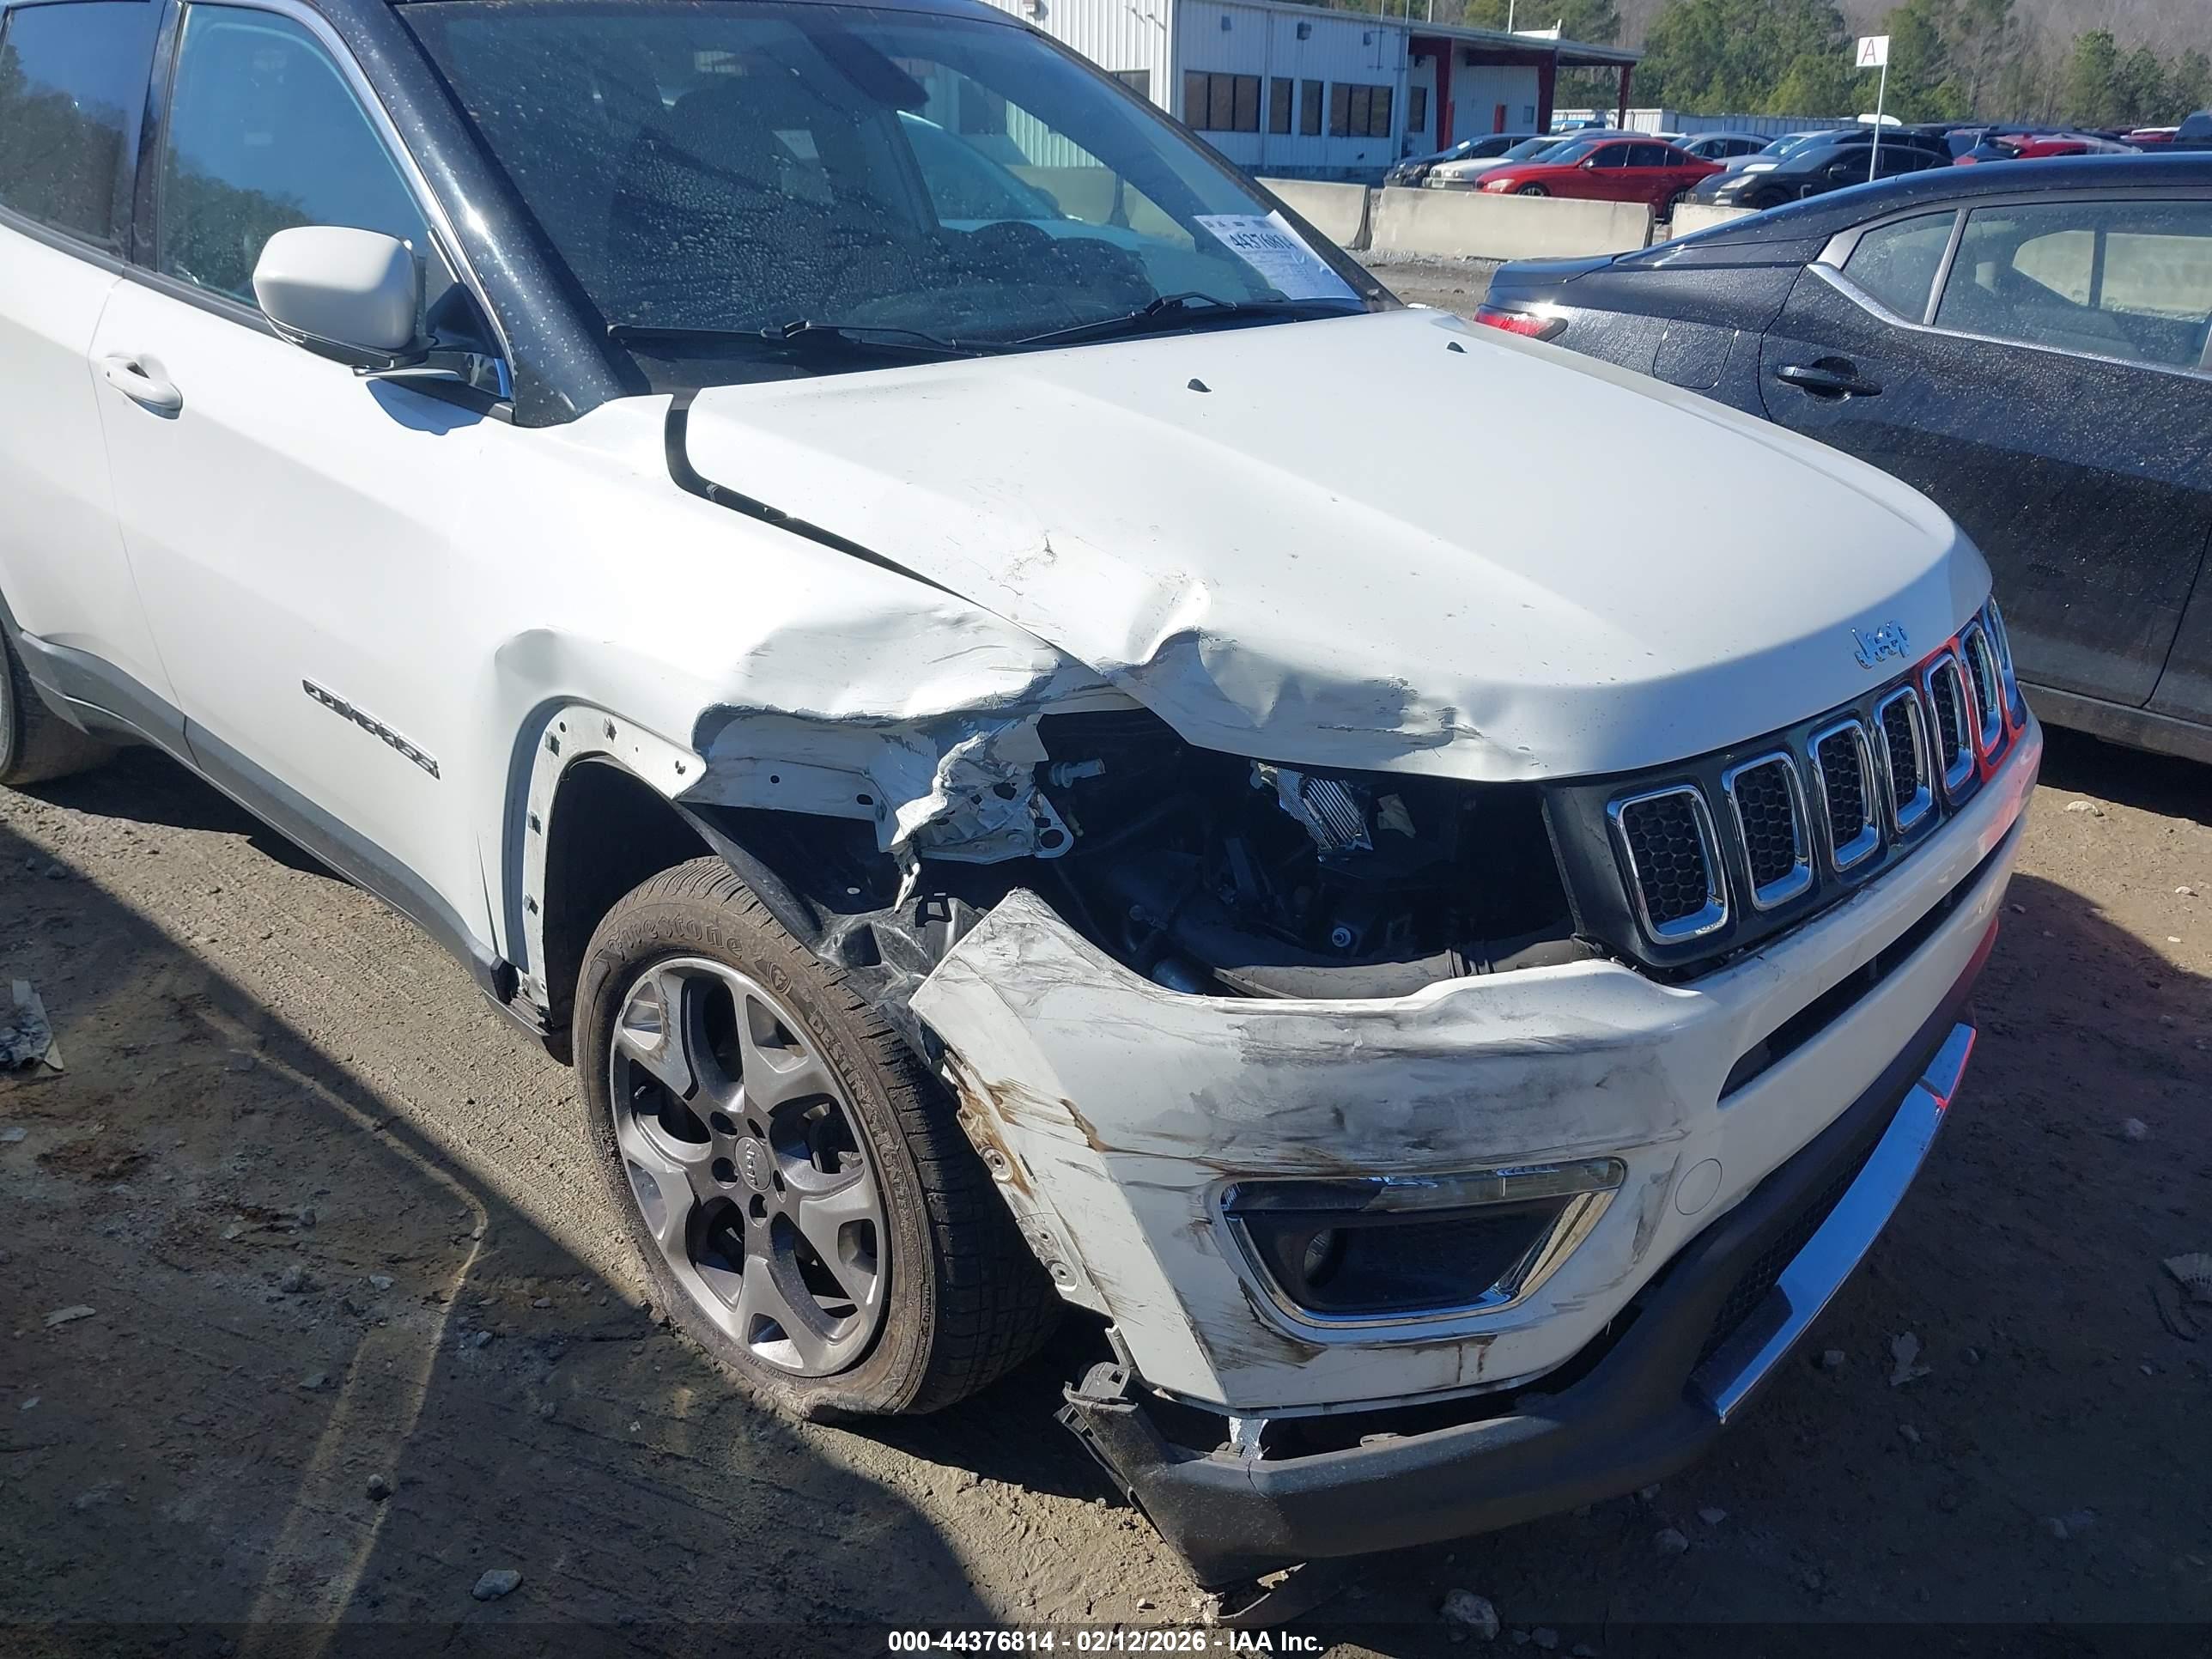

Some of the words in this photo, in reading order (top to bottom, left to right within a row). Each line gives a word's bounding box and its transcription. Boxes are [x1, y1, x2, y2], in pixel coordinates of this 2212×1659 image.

[1862, 39, 1876, 64] A
[1230, 233, 1298, 249] 44376814
[1851, 621, 1911, 670] Jeep
[606, 913, 743, 961] Firestone
